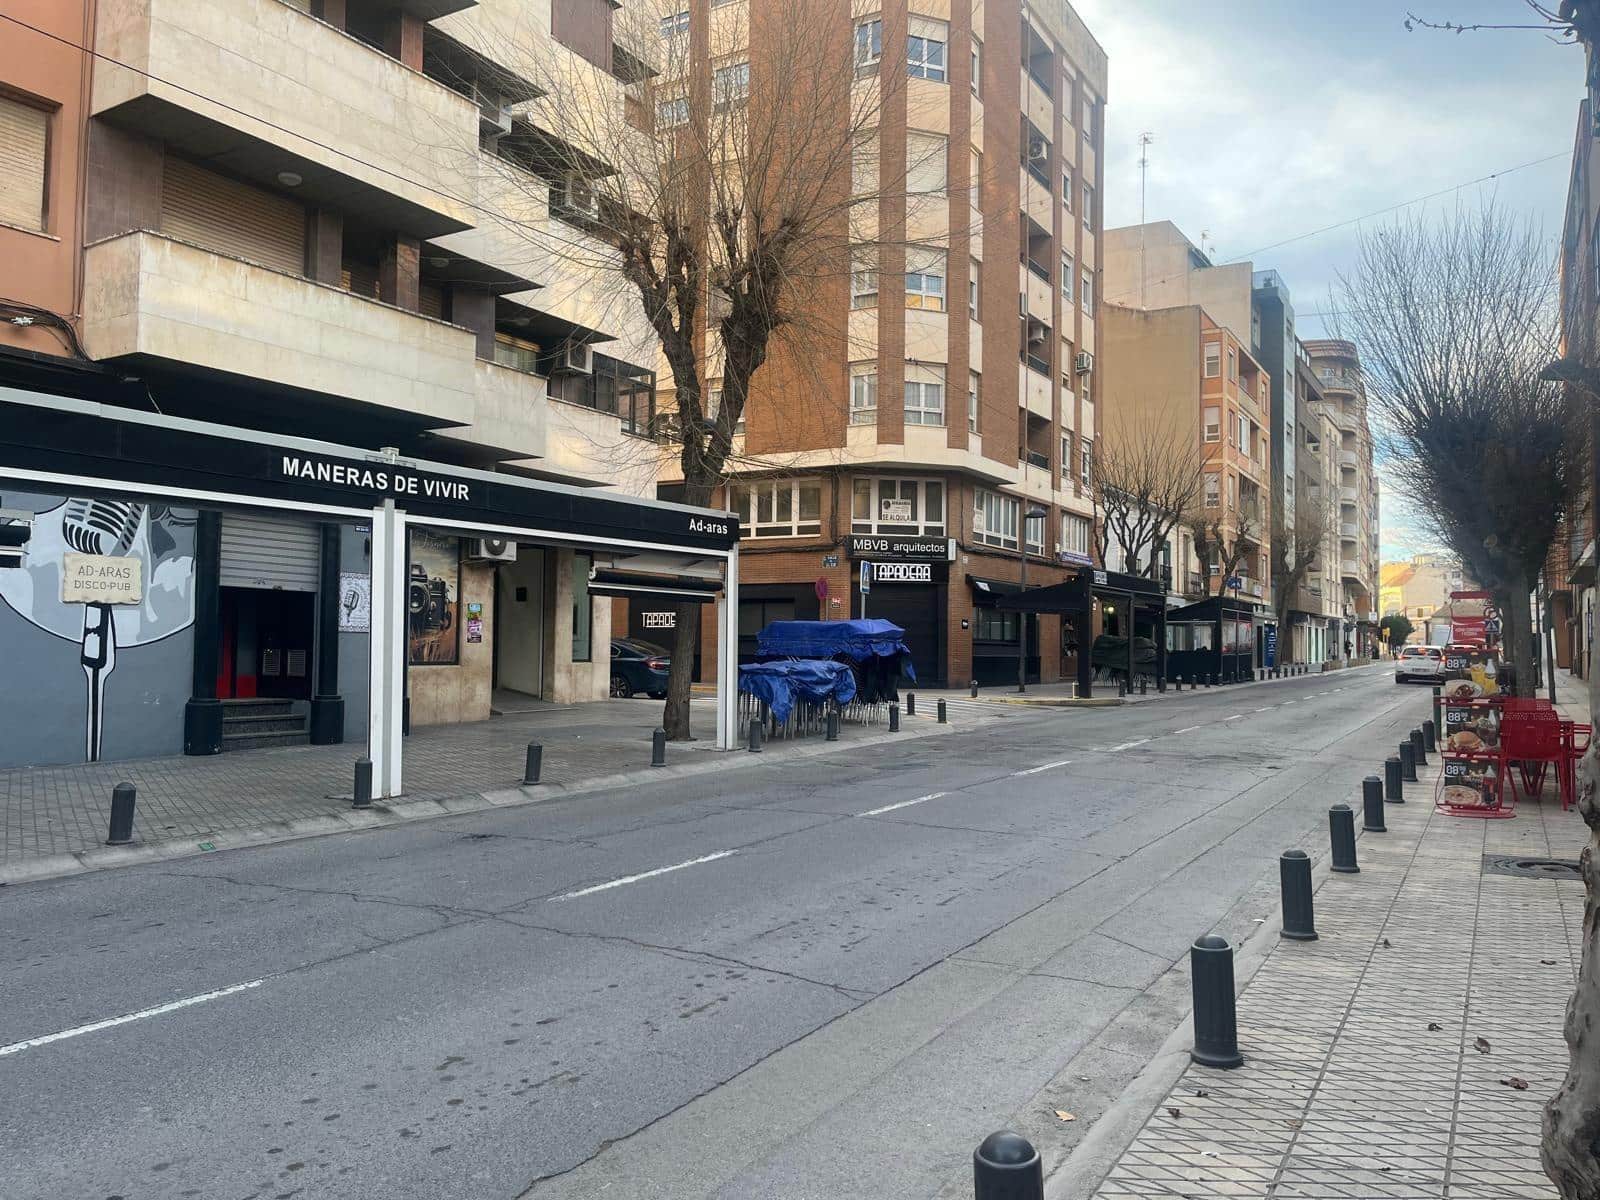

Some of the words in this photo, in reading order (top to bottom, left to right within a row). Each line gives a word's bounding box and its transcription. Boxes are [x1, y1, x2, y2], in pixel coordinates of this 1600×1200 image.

[282, 456, 389, 491] MANERAS
[394, 474, 418, 495] DE
[423, 478, 470, 501] VIVIR
[689, 518, 728, 535] Ad-aras
[853, 539, 889, 551] MBVB
[893, 543, 945, 554] arquitectos
[78, 565, 131, 579] AD-ARAS
[871, 562, 932, 582] TAPADERA
[74, 579, 131, 591] DISCO-PUB
[641, 612, 677, 628] TAPADE
